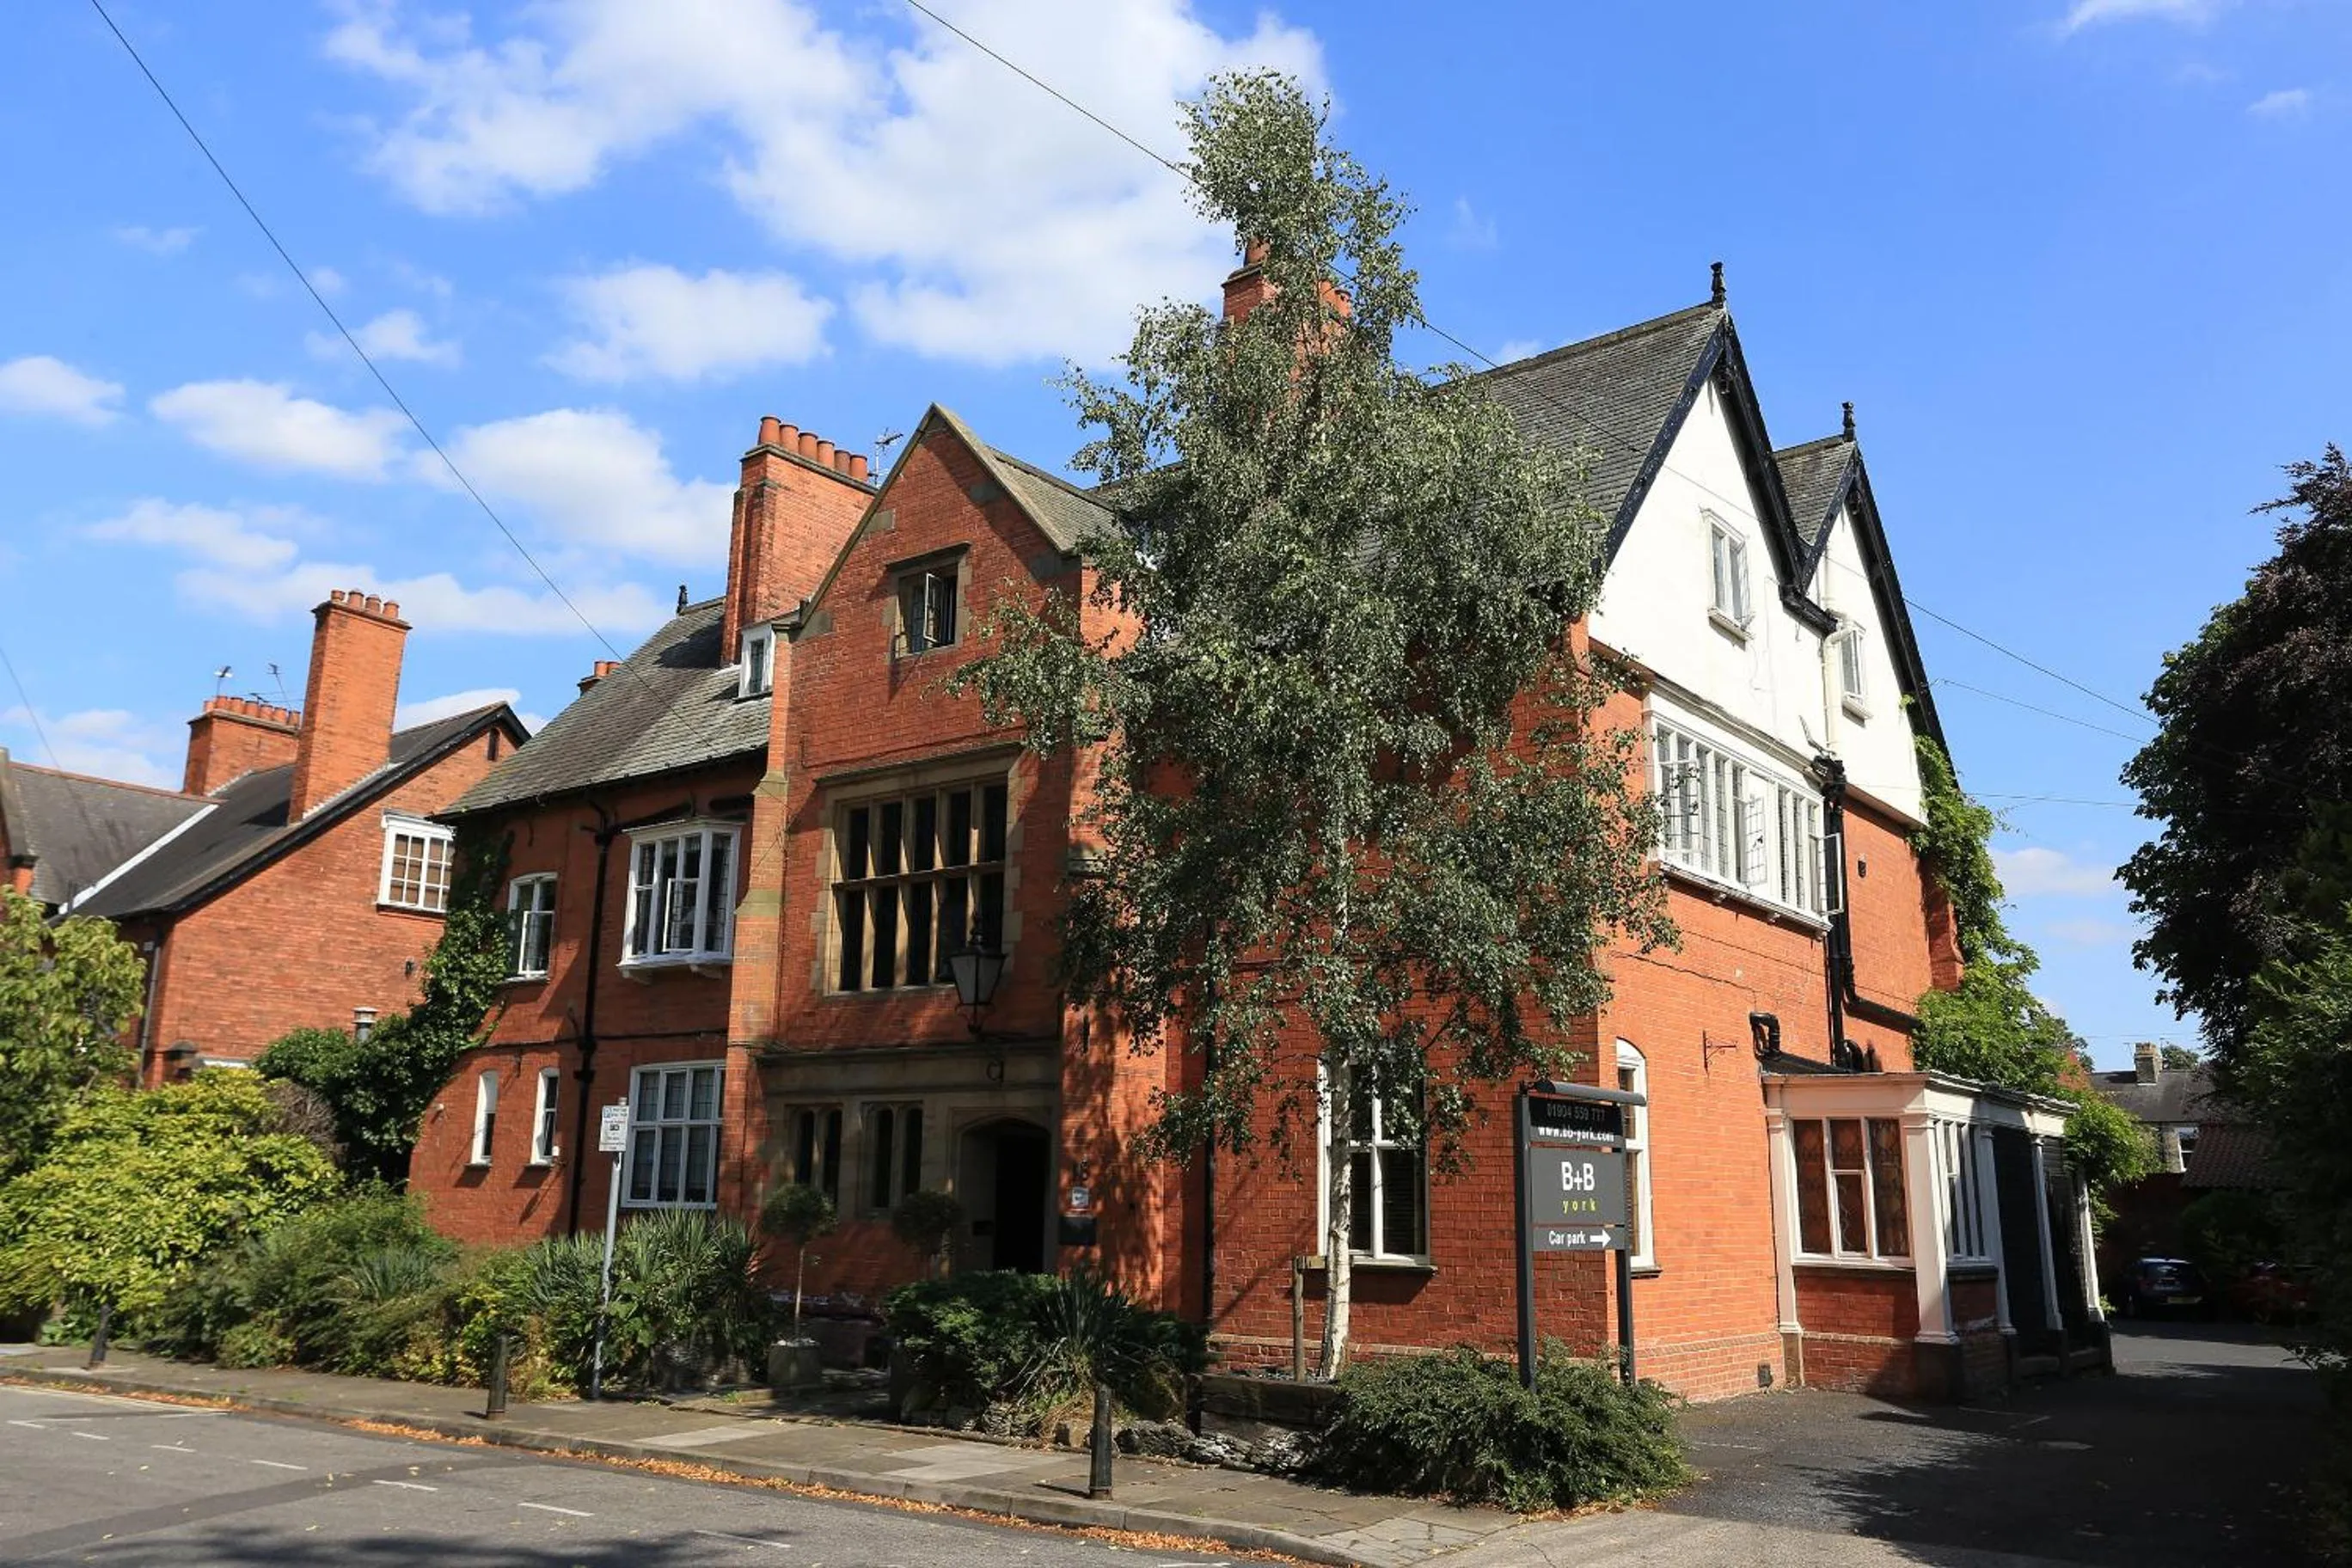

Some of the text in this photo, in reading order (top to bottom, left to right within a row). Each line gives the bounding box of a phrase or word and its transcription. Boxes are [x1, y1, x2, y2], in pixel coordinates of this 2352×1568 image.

[1561, 1161, 1595, 1191] B+B
[1563, 1197, 1596, 1214] york
[1548, 1230, 1586, 1247] Car park
